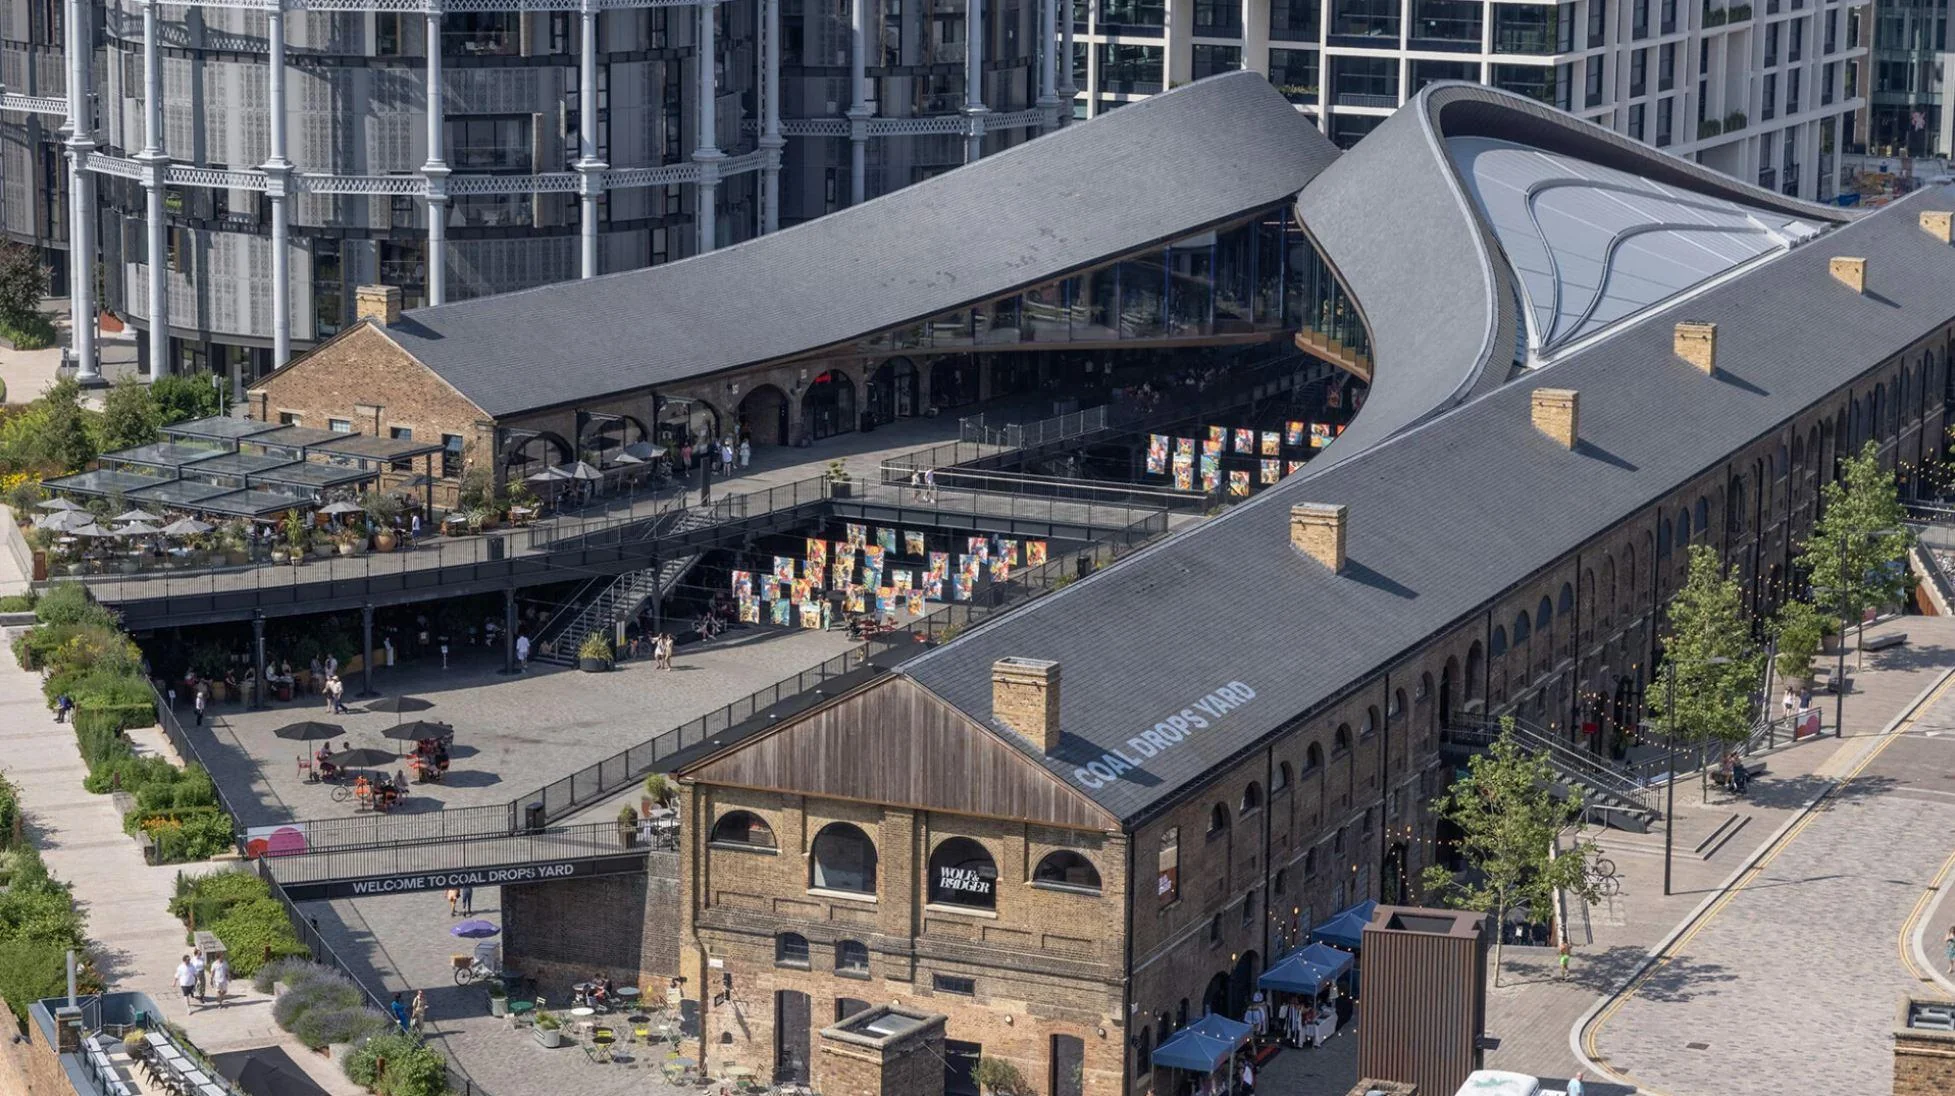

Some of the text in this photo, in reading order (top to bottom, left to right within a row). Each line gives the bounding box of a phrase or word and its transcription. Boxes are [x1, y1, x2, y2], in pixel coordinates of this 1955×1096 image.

[1074, 680, 1256, 789] COAL DROPS YARD
[353, 864, 574, 894] WELCOME TO COAL DROPS YARD
